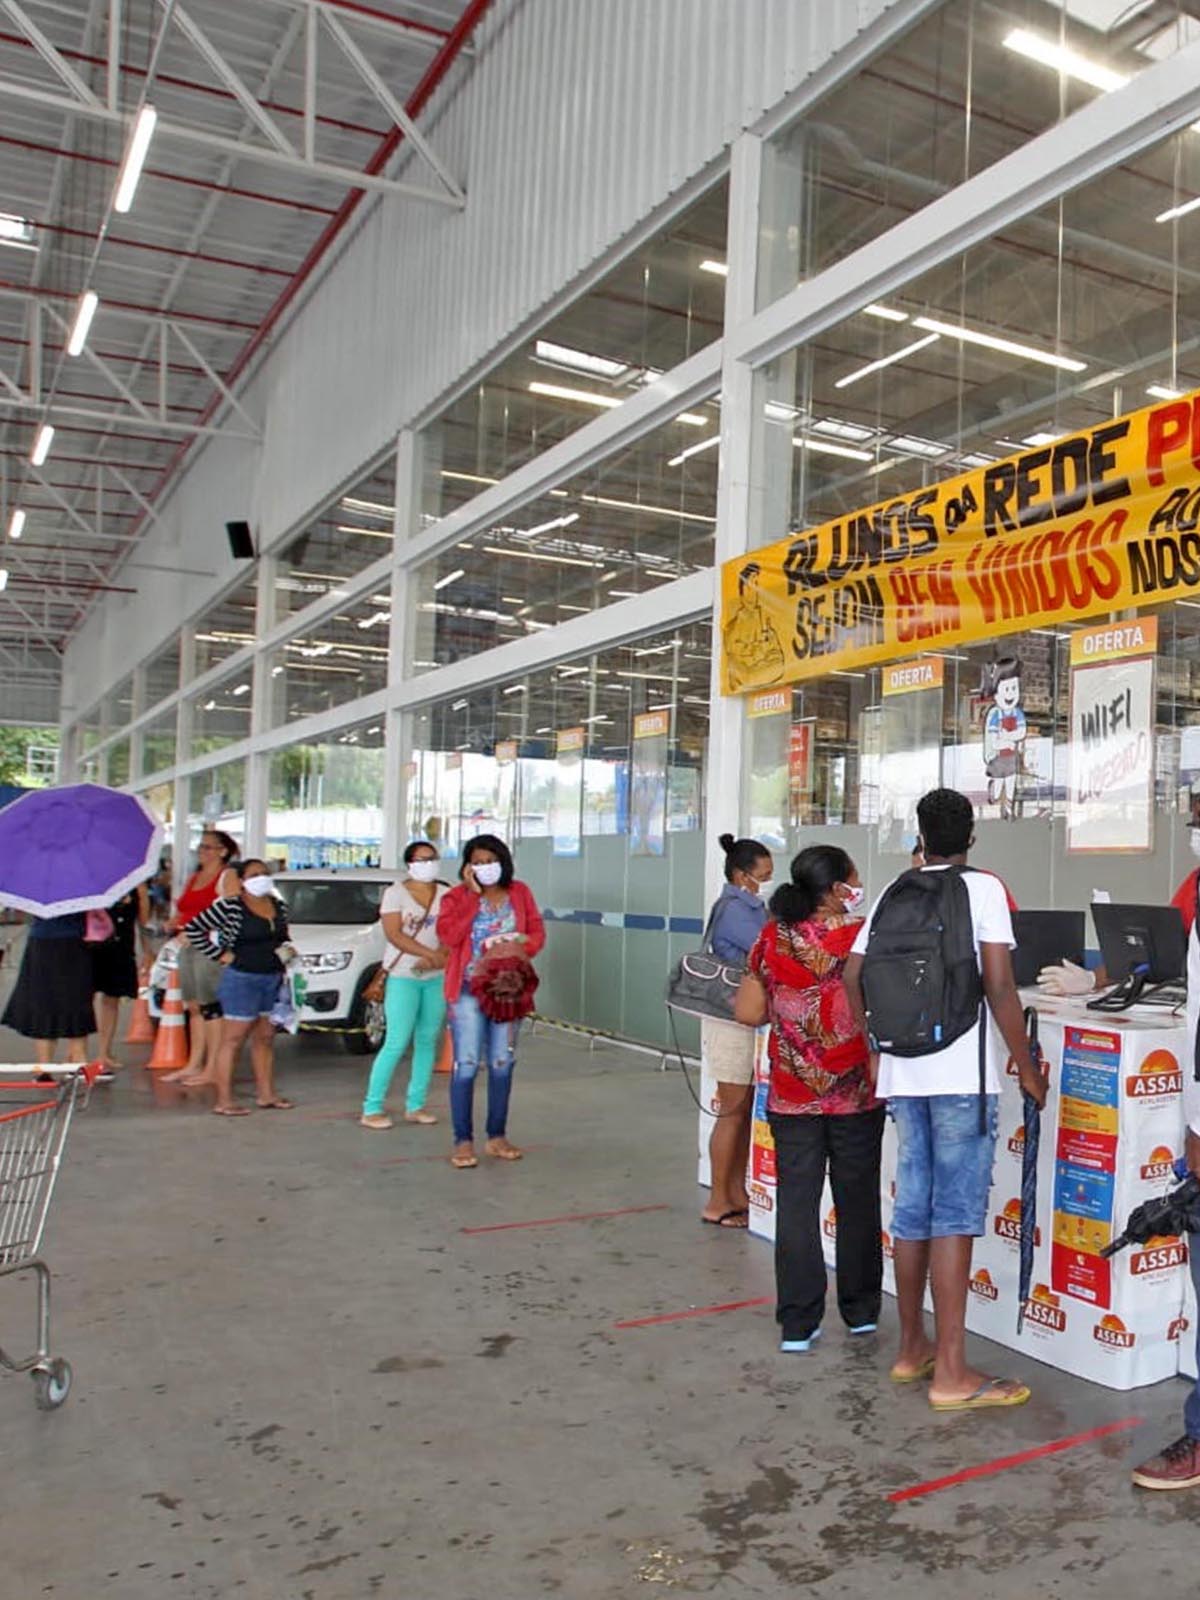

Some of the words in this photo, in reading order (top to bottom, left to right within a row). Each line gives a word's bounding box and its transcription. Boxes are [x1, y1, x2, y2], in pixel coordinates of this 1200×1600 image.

[984, 420, 1132, 538] REDE
[792, 572, 884, 660] SEJAM
[889, 556, 961, 643] BEM
[966, 508, 1129, 624] VINDOS
[1083, 626, 1144, 654] OFERTA
[890, 665, 933, 688] OFERTA
[1081, 687, 1131, 750] WIFI
